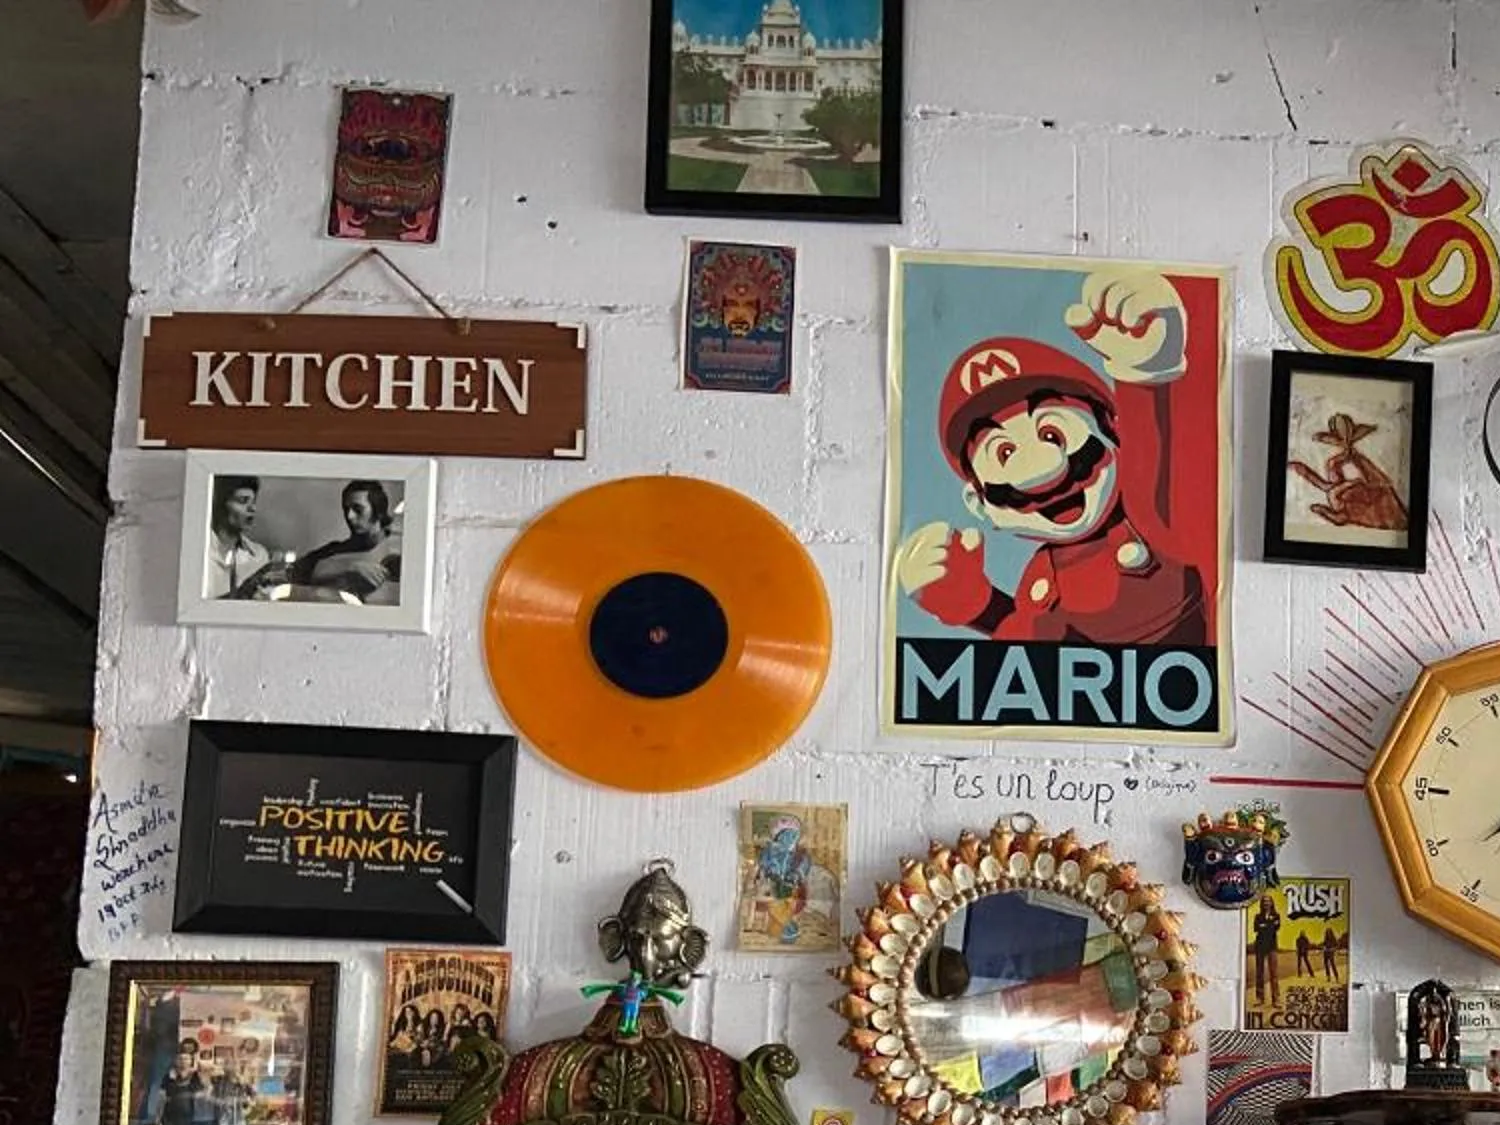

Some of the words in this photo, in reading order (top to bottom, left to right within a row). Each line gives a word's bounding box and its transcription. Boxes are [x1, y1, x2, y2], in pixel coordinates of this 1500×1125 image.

[189, 350, 534, 415] KITCHEN
[901, 642, 1214, 726] MARIO
[1436, 726, 1452, 745] 50
[919, 761, 984, 800] T'es
[997, 774, 1036, 800] un
[1046, 768, 1115, 824] loup
[1415, 777, 1429, 801] 45
[260, 804, 410, 833] POSITIVE
[293, 835, 445, 864] THINKING
[1426, 838, 1439, 857] 40
[1284, 883, 1345, 917] RUSH
[1460, 886, 1479, 903] 35
[1247, 1011, 1263, 1030] IN
